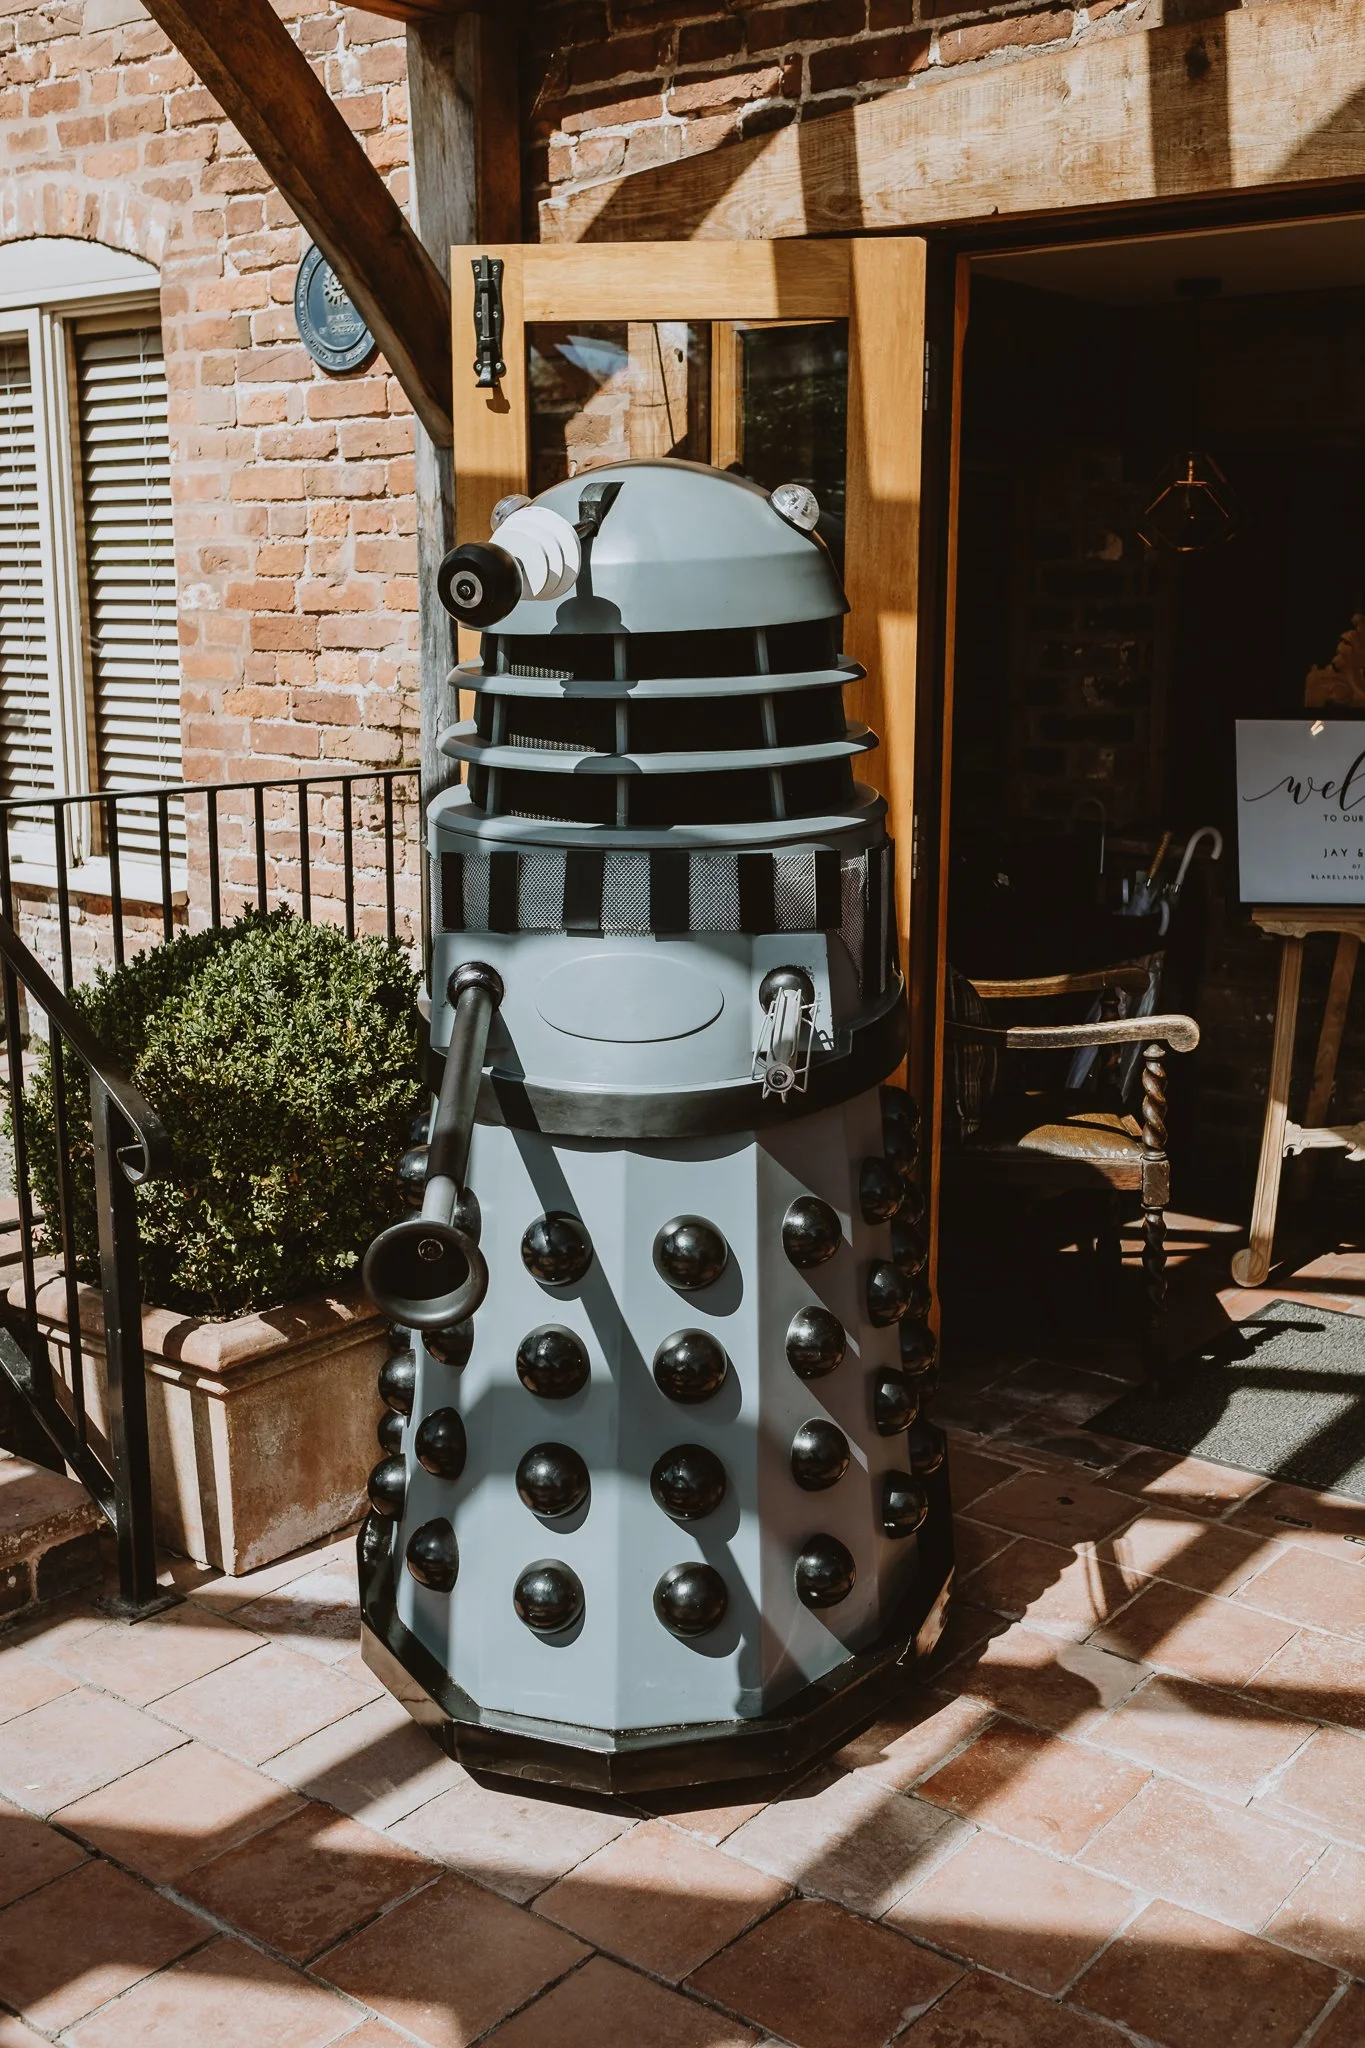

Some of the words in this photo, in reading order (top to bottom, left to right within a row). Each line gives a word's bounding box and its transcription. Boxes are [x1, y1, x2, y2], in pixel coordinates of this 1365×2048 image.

[1323, 814, 1338, 822] TO
[1342, 814, 1364, 822] OUR
[1323, 848, 1348, 858] JAY
[1357, 848, 1365, 858] &
